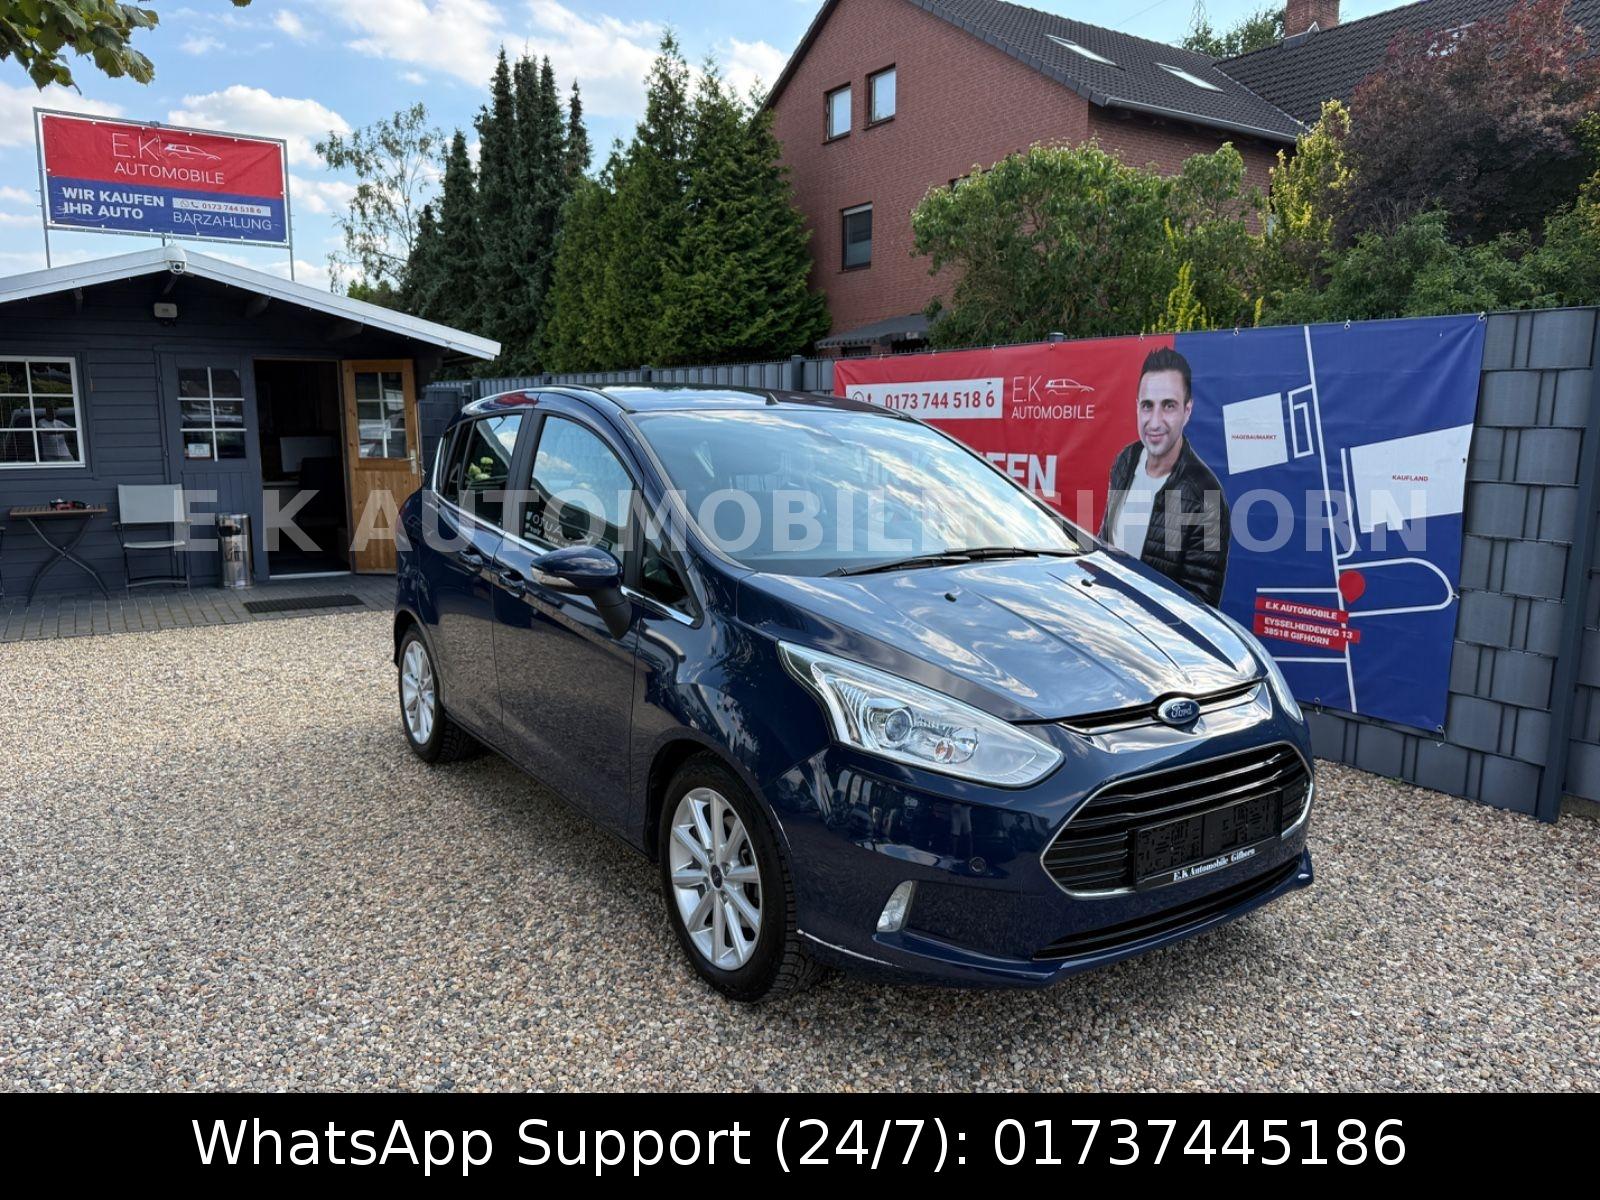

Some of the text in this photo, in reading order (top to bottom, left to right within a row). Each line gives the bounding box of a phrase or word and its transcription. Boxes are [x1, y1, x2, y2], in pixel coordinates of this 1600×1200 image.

[114, 162, 225, 185] AUTOMOBILE
[62, 187, 165, 207] WIR KAUFEN
[64, 202, 144, 220] IHR AUTO
[173, 211, 272, 231] BARZAHLUNG
[1012, 375, 1043, 402] E.K
[885, 390, 996, 410] 0173 744 518 6
[1011, 404, 1096, 420] AUTOMOBILE
[1392, 474, 1429, 482] KAUFLAND
[1265, 601, 1338, 620] E.K AUTOMOBILE
[1263, 626, 1330, 645] 38518 GIFHORN
[1264, 617, 1353, 639] EYSSELHEIDEWEG 13
[1171, 702, 1193, 718] Ford
[1189, 856, 1229, 877] Automobile
[1231, 848, 1256, 863] Gifhorn
